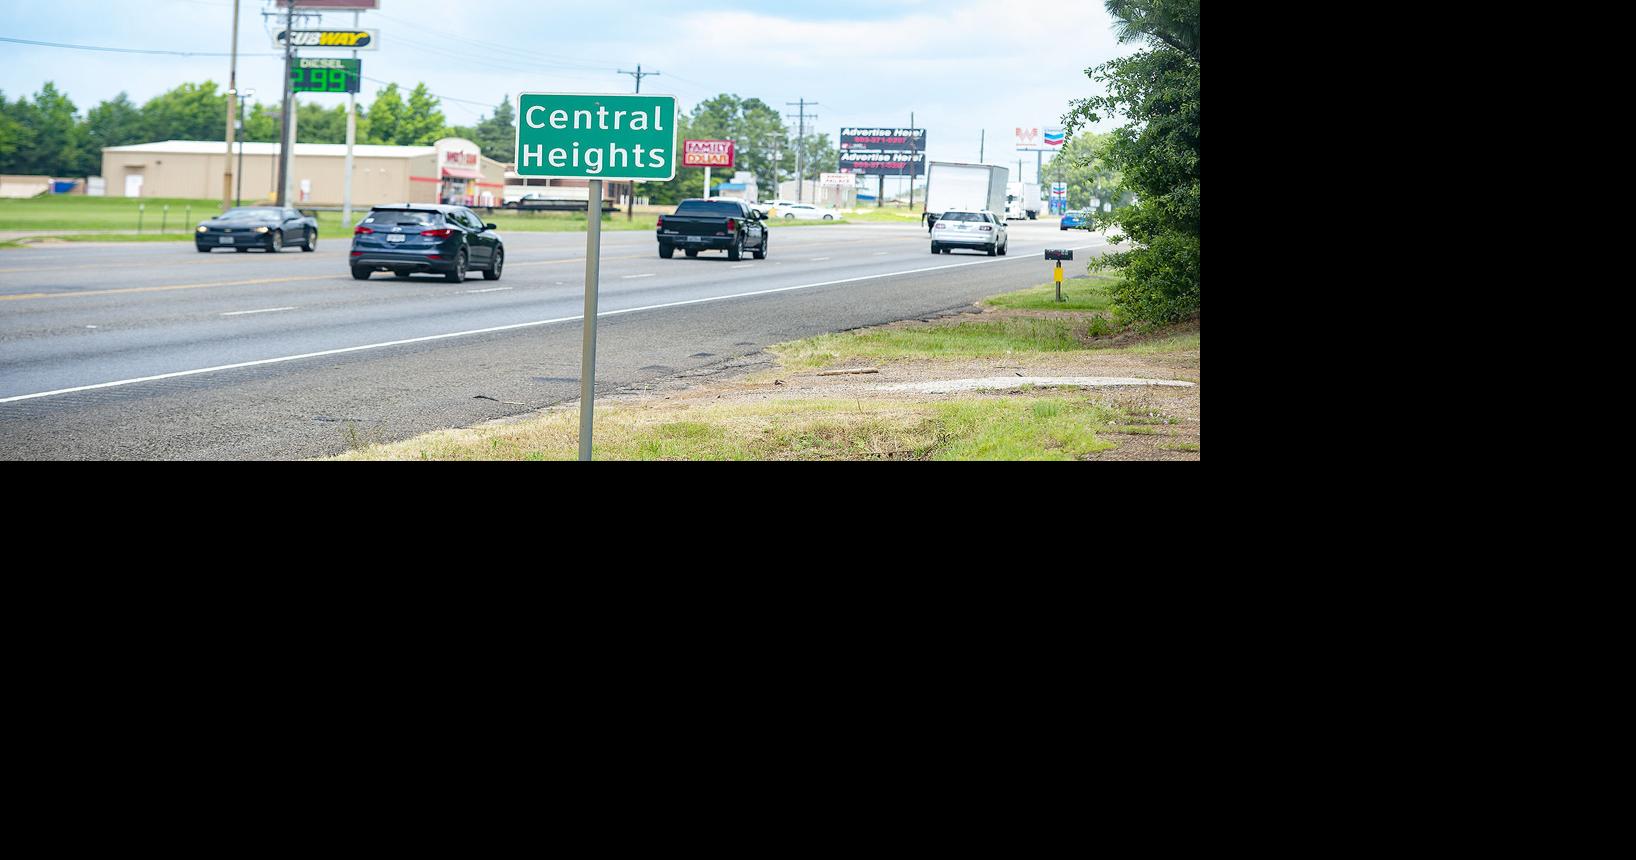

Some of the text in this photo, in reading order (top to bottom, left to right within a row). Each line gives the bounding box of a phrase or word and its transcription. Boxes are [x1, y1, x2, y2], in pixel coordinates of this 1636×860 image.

[300, 59, 344, 68] DIESEL
[525, 105, 663, 131] Central
[842, 128, 924, 137] Advertise Here!
[688, 143, 727, 152] FAMILY
[523, 141, 665, 174] Heights
[841, 153, 923, 162] Advertise Here!
